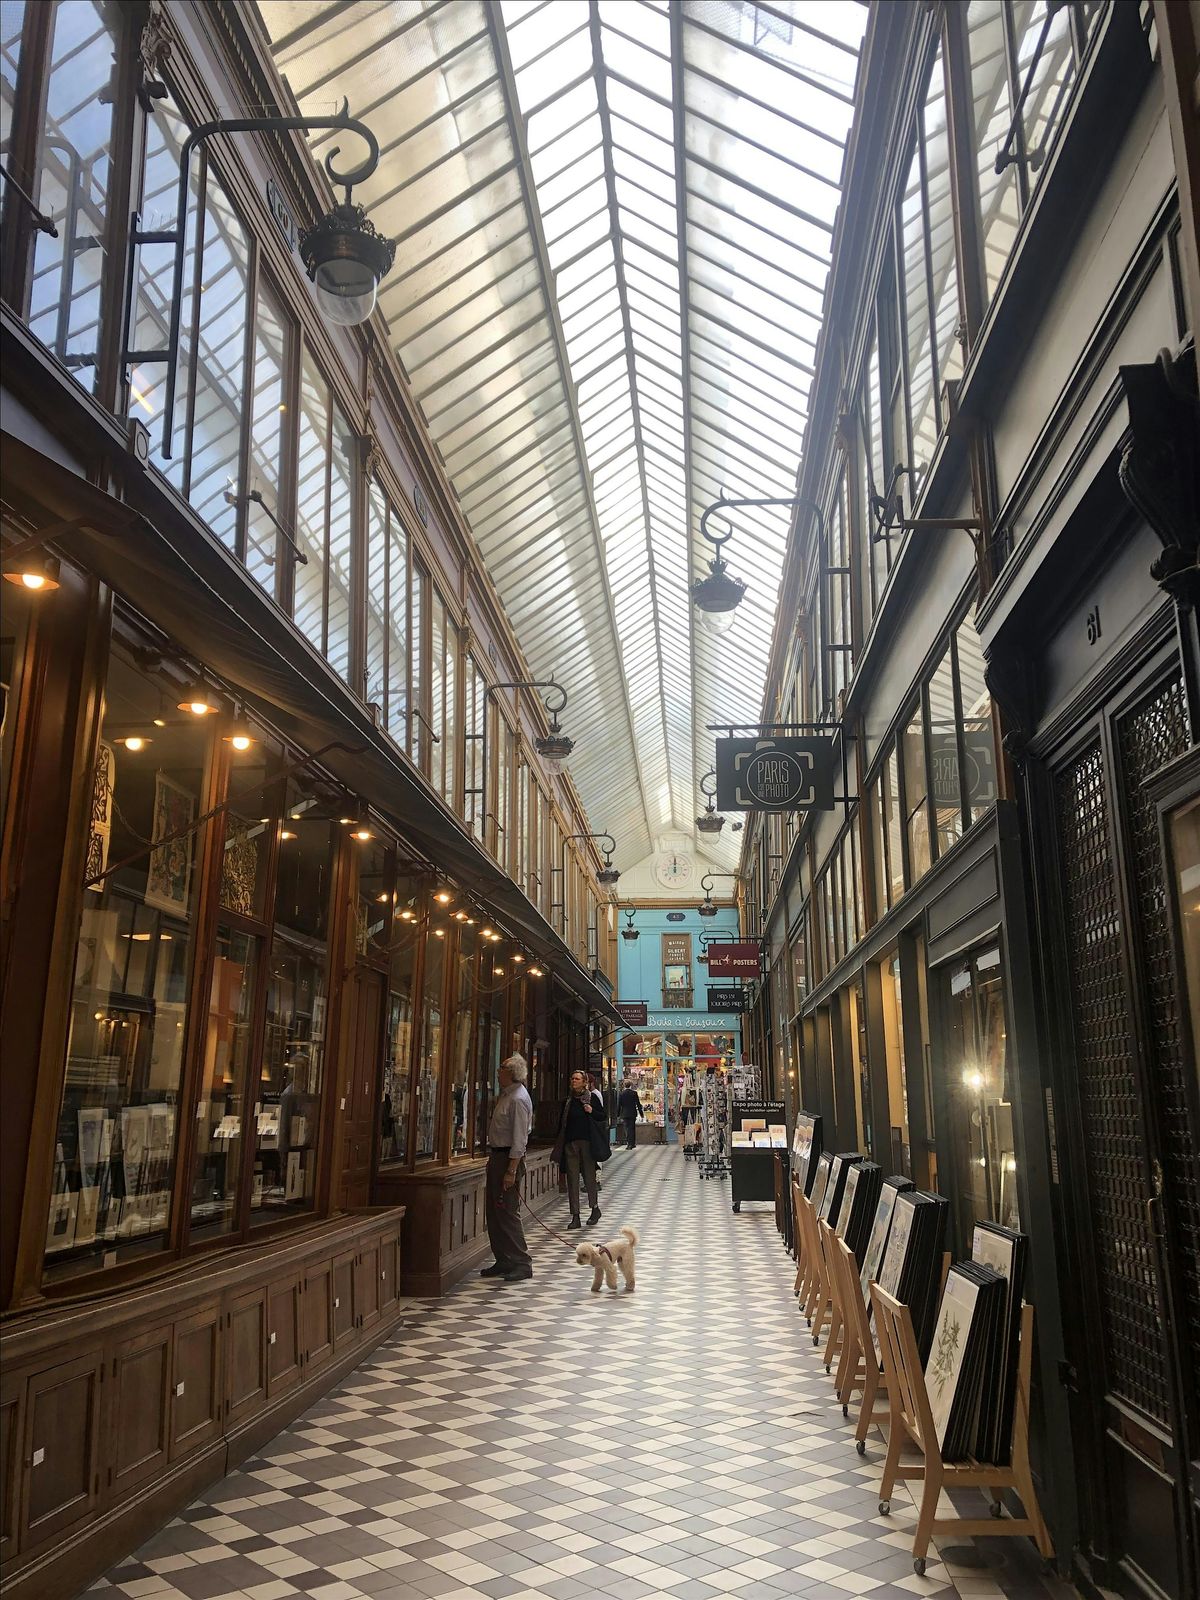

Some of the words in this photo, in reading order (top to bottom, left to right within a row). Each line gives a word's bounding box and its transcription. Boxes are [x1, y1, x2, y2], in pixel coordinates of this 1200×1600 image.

[1087, 605, 1102, 646] 61
[757, 760, 789, 784] PARIS
[765, 783, 789, 798] PHOTO
